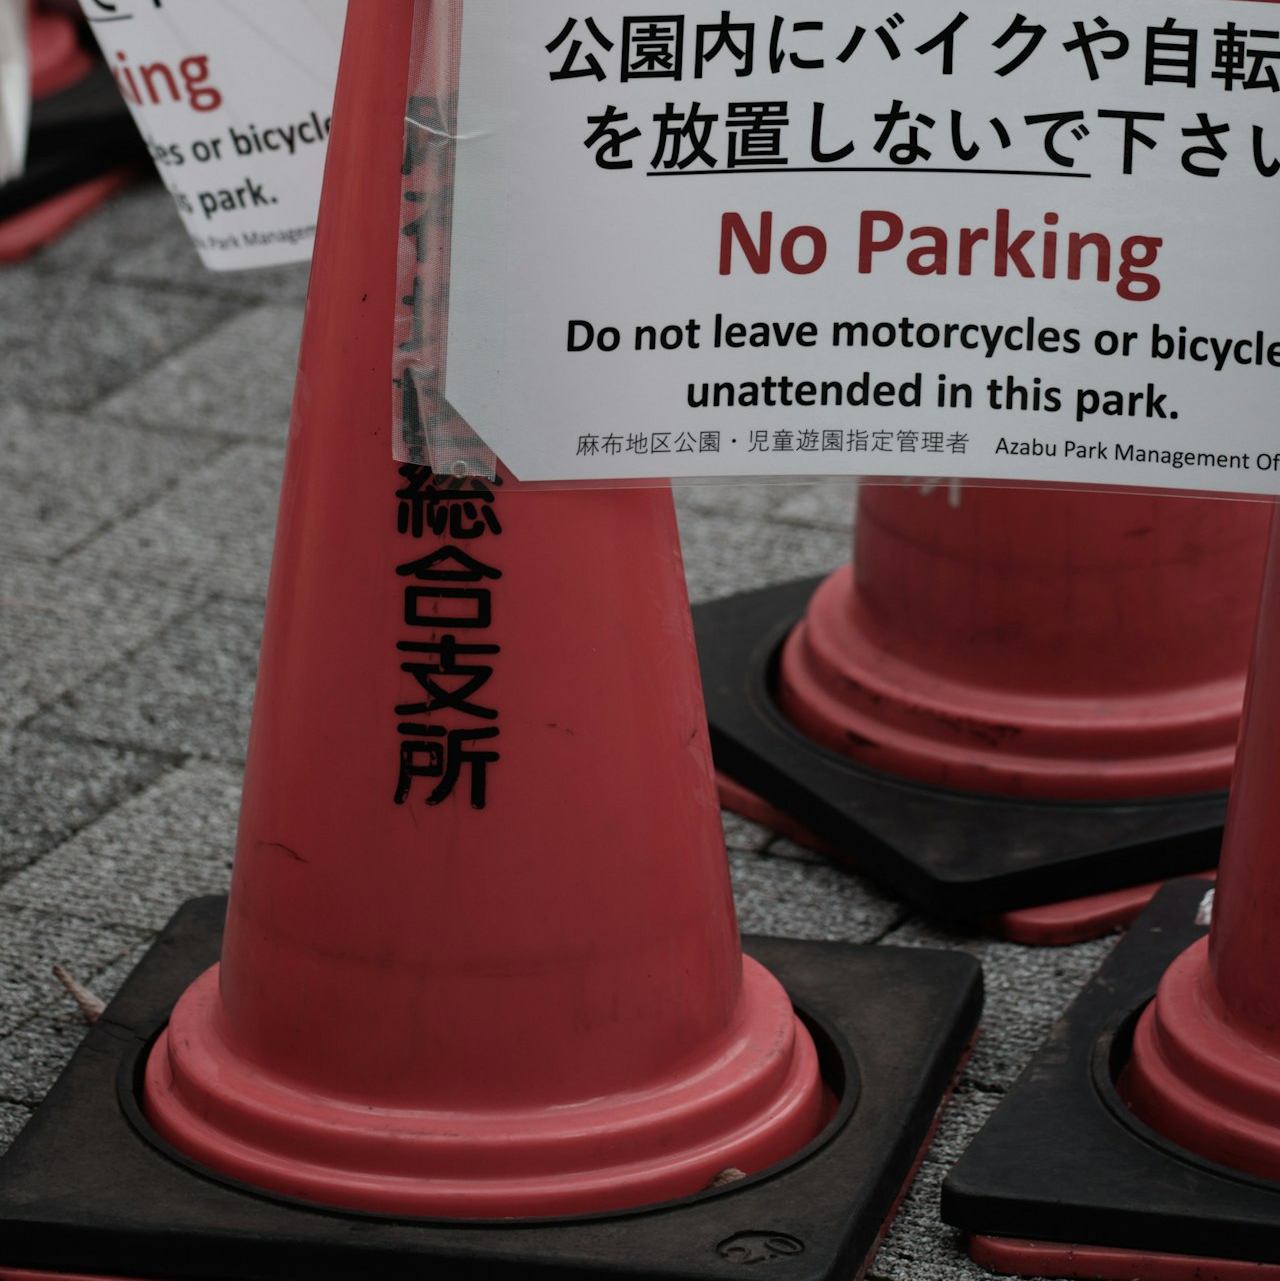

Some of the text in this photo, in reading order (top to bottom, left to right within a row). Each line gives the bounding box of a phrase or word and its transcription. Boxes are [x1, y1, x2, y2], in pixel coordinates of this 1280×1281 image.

[191, 139, 223, 164] or
[199, 178, 278, 221] park.
[718, 208, 1164, 302] No Parking
[566, 319, 621, 353] Do
[634, 318, 702, 351] not
[713, 313, 819, 349] leave
[831, 315, 1082, 359] motorcycles
[1093, 329, 1139, 358] or
[686, 371, 1179, 423] unattended in this park.
[575, 429, 970, 457] 麻布地区公園・児童遊園指定管理者
[994, 436, 1057, 459] Azabu
[1064, 439, 1108, 461] Park
[1114, 442, 1251, 470] Management
